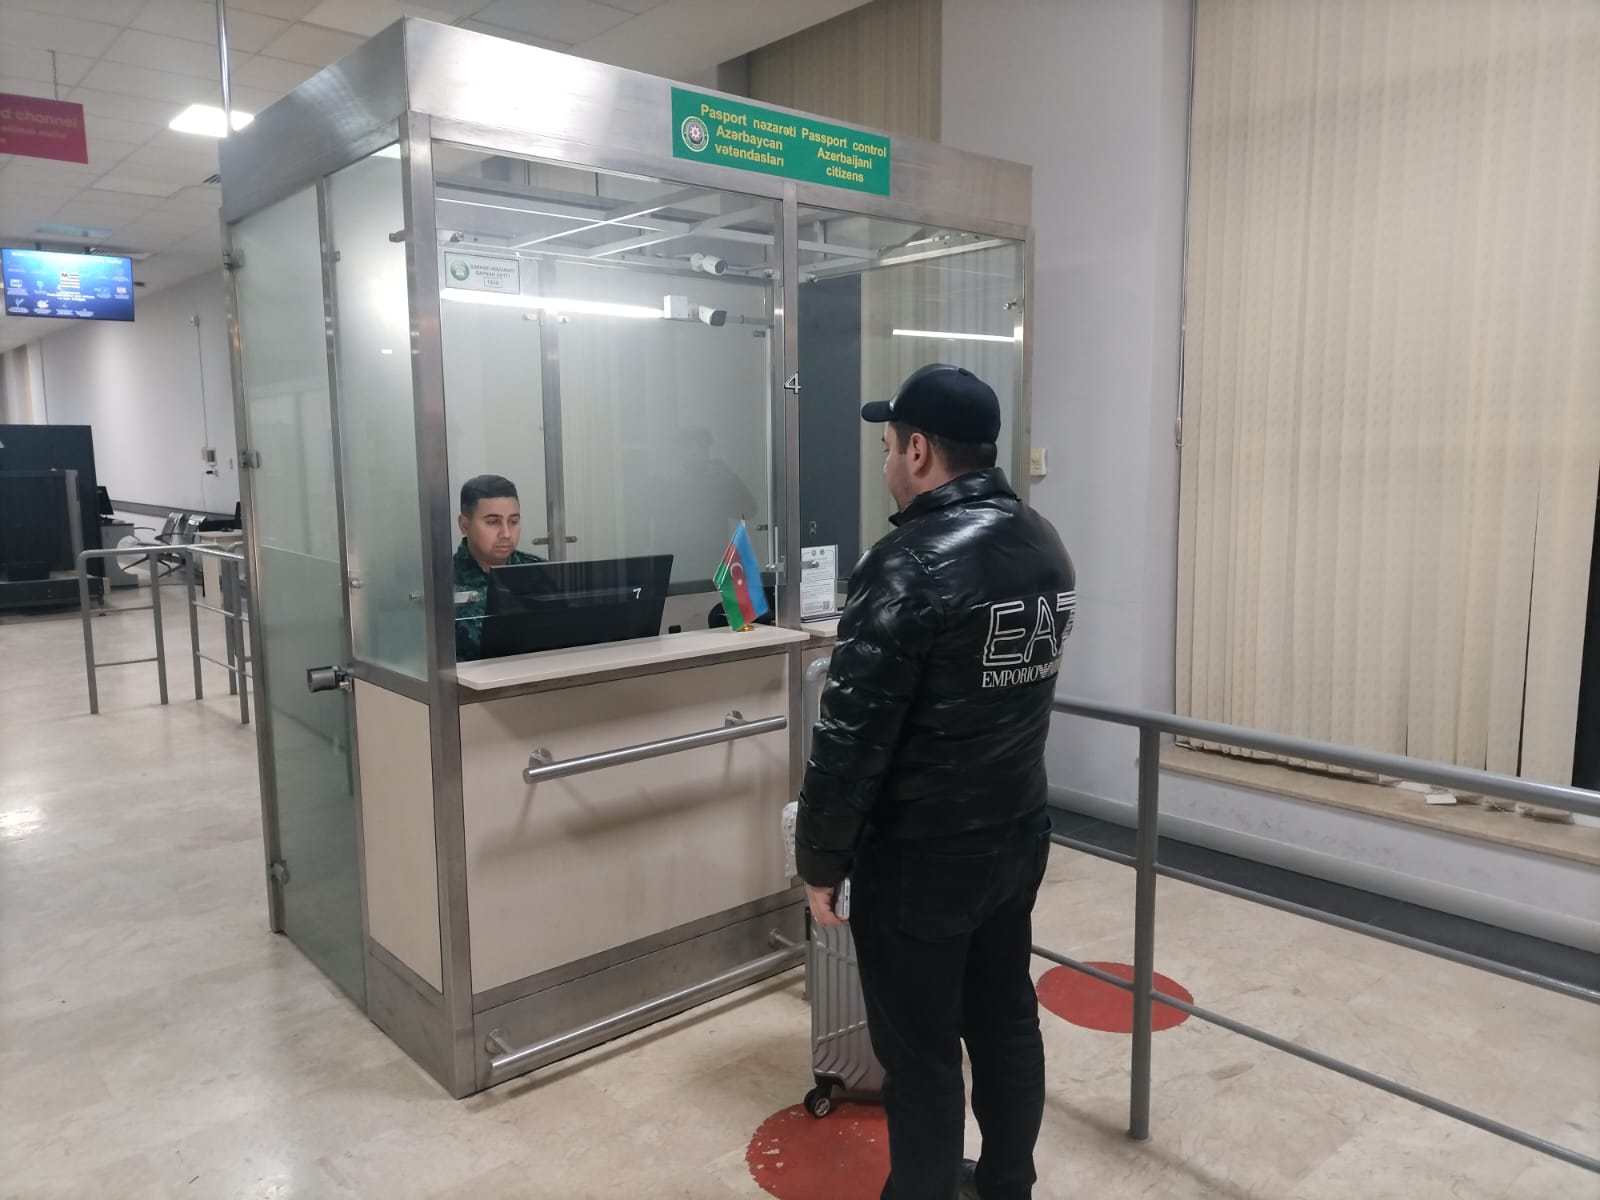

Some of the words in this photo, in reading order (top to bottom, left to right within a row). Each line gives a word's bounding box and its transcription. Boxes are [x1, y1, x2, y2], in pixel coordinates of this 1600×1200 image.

[701, 103, 747, 126] Pasport
[753, 119, 797, 137] nəzarəti
[716, 125, 783, 150] Azərbaycan
[802, 127, 847, 148] Passport
[852, 142, 886, 158] control
[817, 146, 872, 169] Azerbaijani
[826, 165, 864, 182] citizens
[784, 372, 802, 394] 4
[632, 587, 642, 600] 7
[982, 665, 1040, 688] EMPORIO
